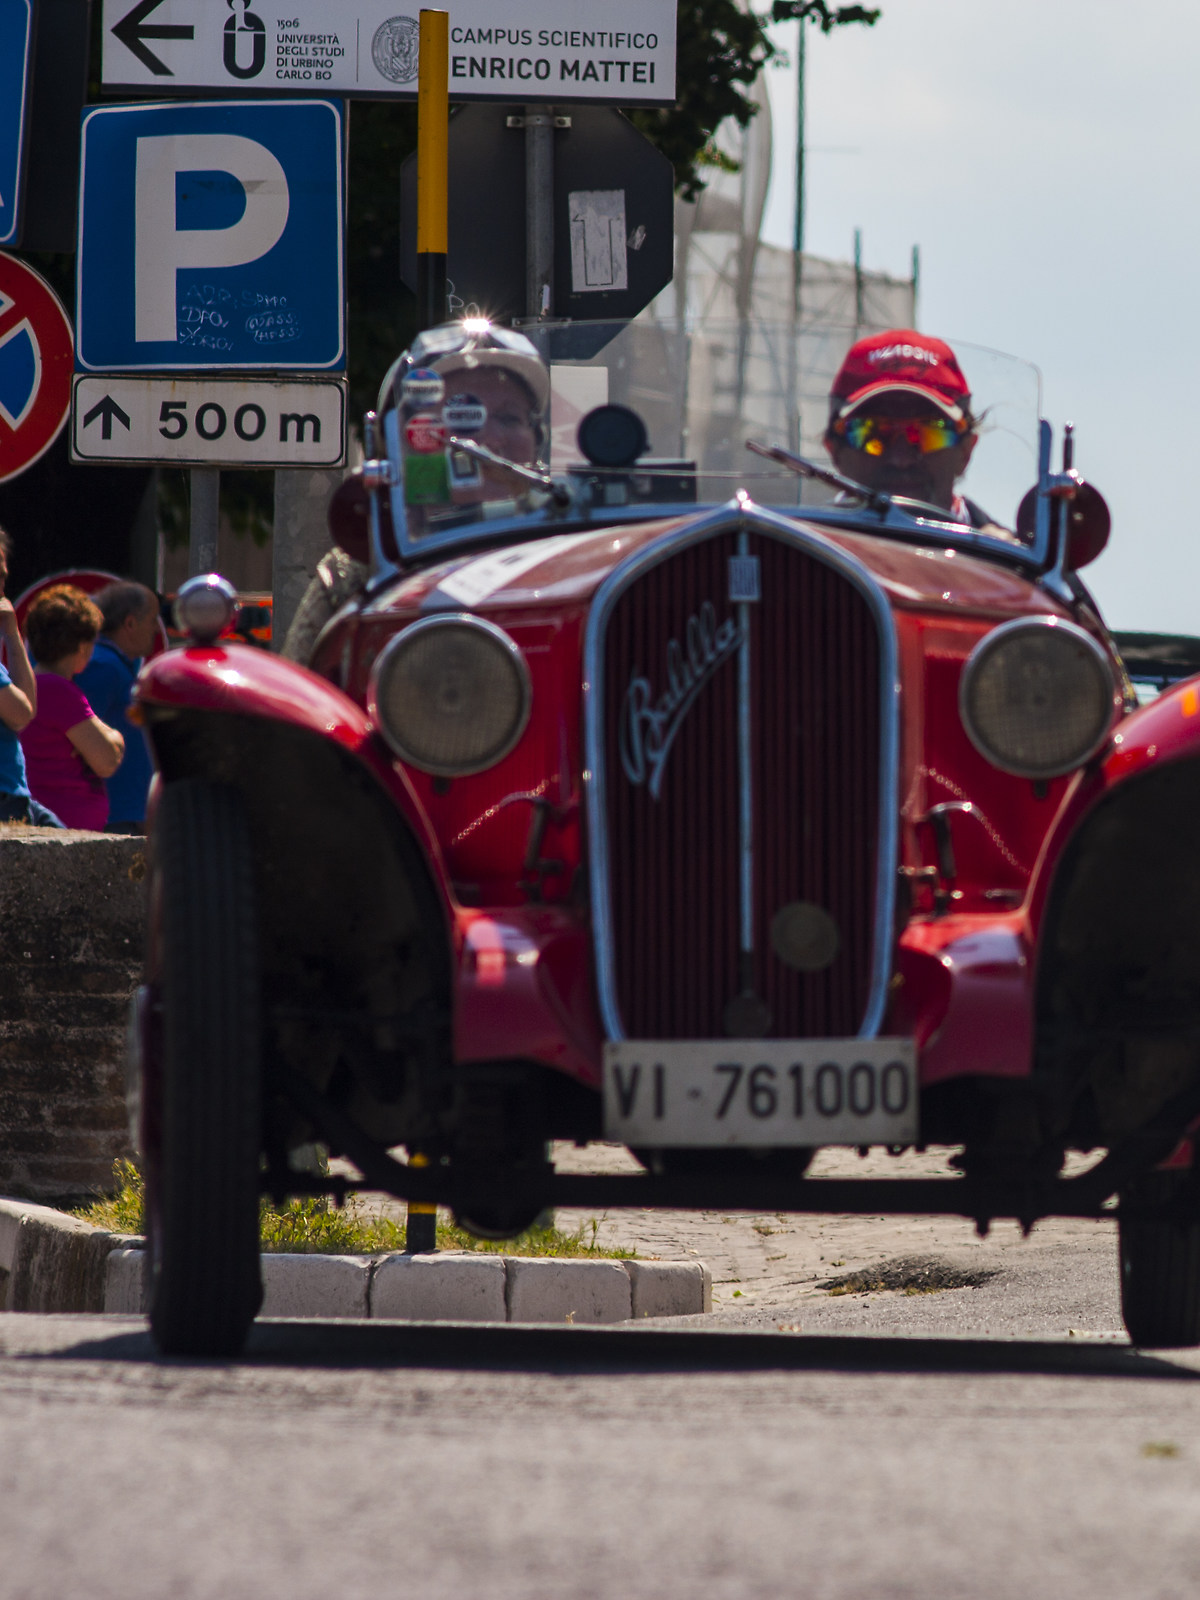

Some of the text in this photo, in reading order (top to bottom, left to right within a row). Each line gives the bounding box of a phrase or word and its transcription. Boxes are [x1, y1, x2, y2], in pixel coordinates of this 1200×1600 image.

[277, 18, 300, 30] 1506
[277, 32, 340, 45] UNIVERSITÀ
[451, 27, 658, 49] CAMPUS SCIENTIFICO
[277, 46, 345, 57] DEGLI STUDI
[277, 57, 334, 69] DI URBINO
[452, 56, 655, 83] ENRICO MATTEI
[276, 69, 332, 80] CARLO BO
[135, 134, 290, 342] P
[158, 401, 321, 443] 500 m
[612, 1060, 910, 1120] VI 761000
